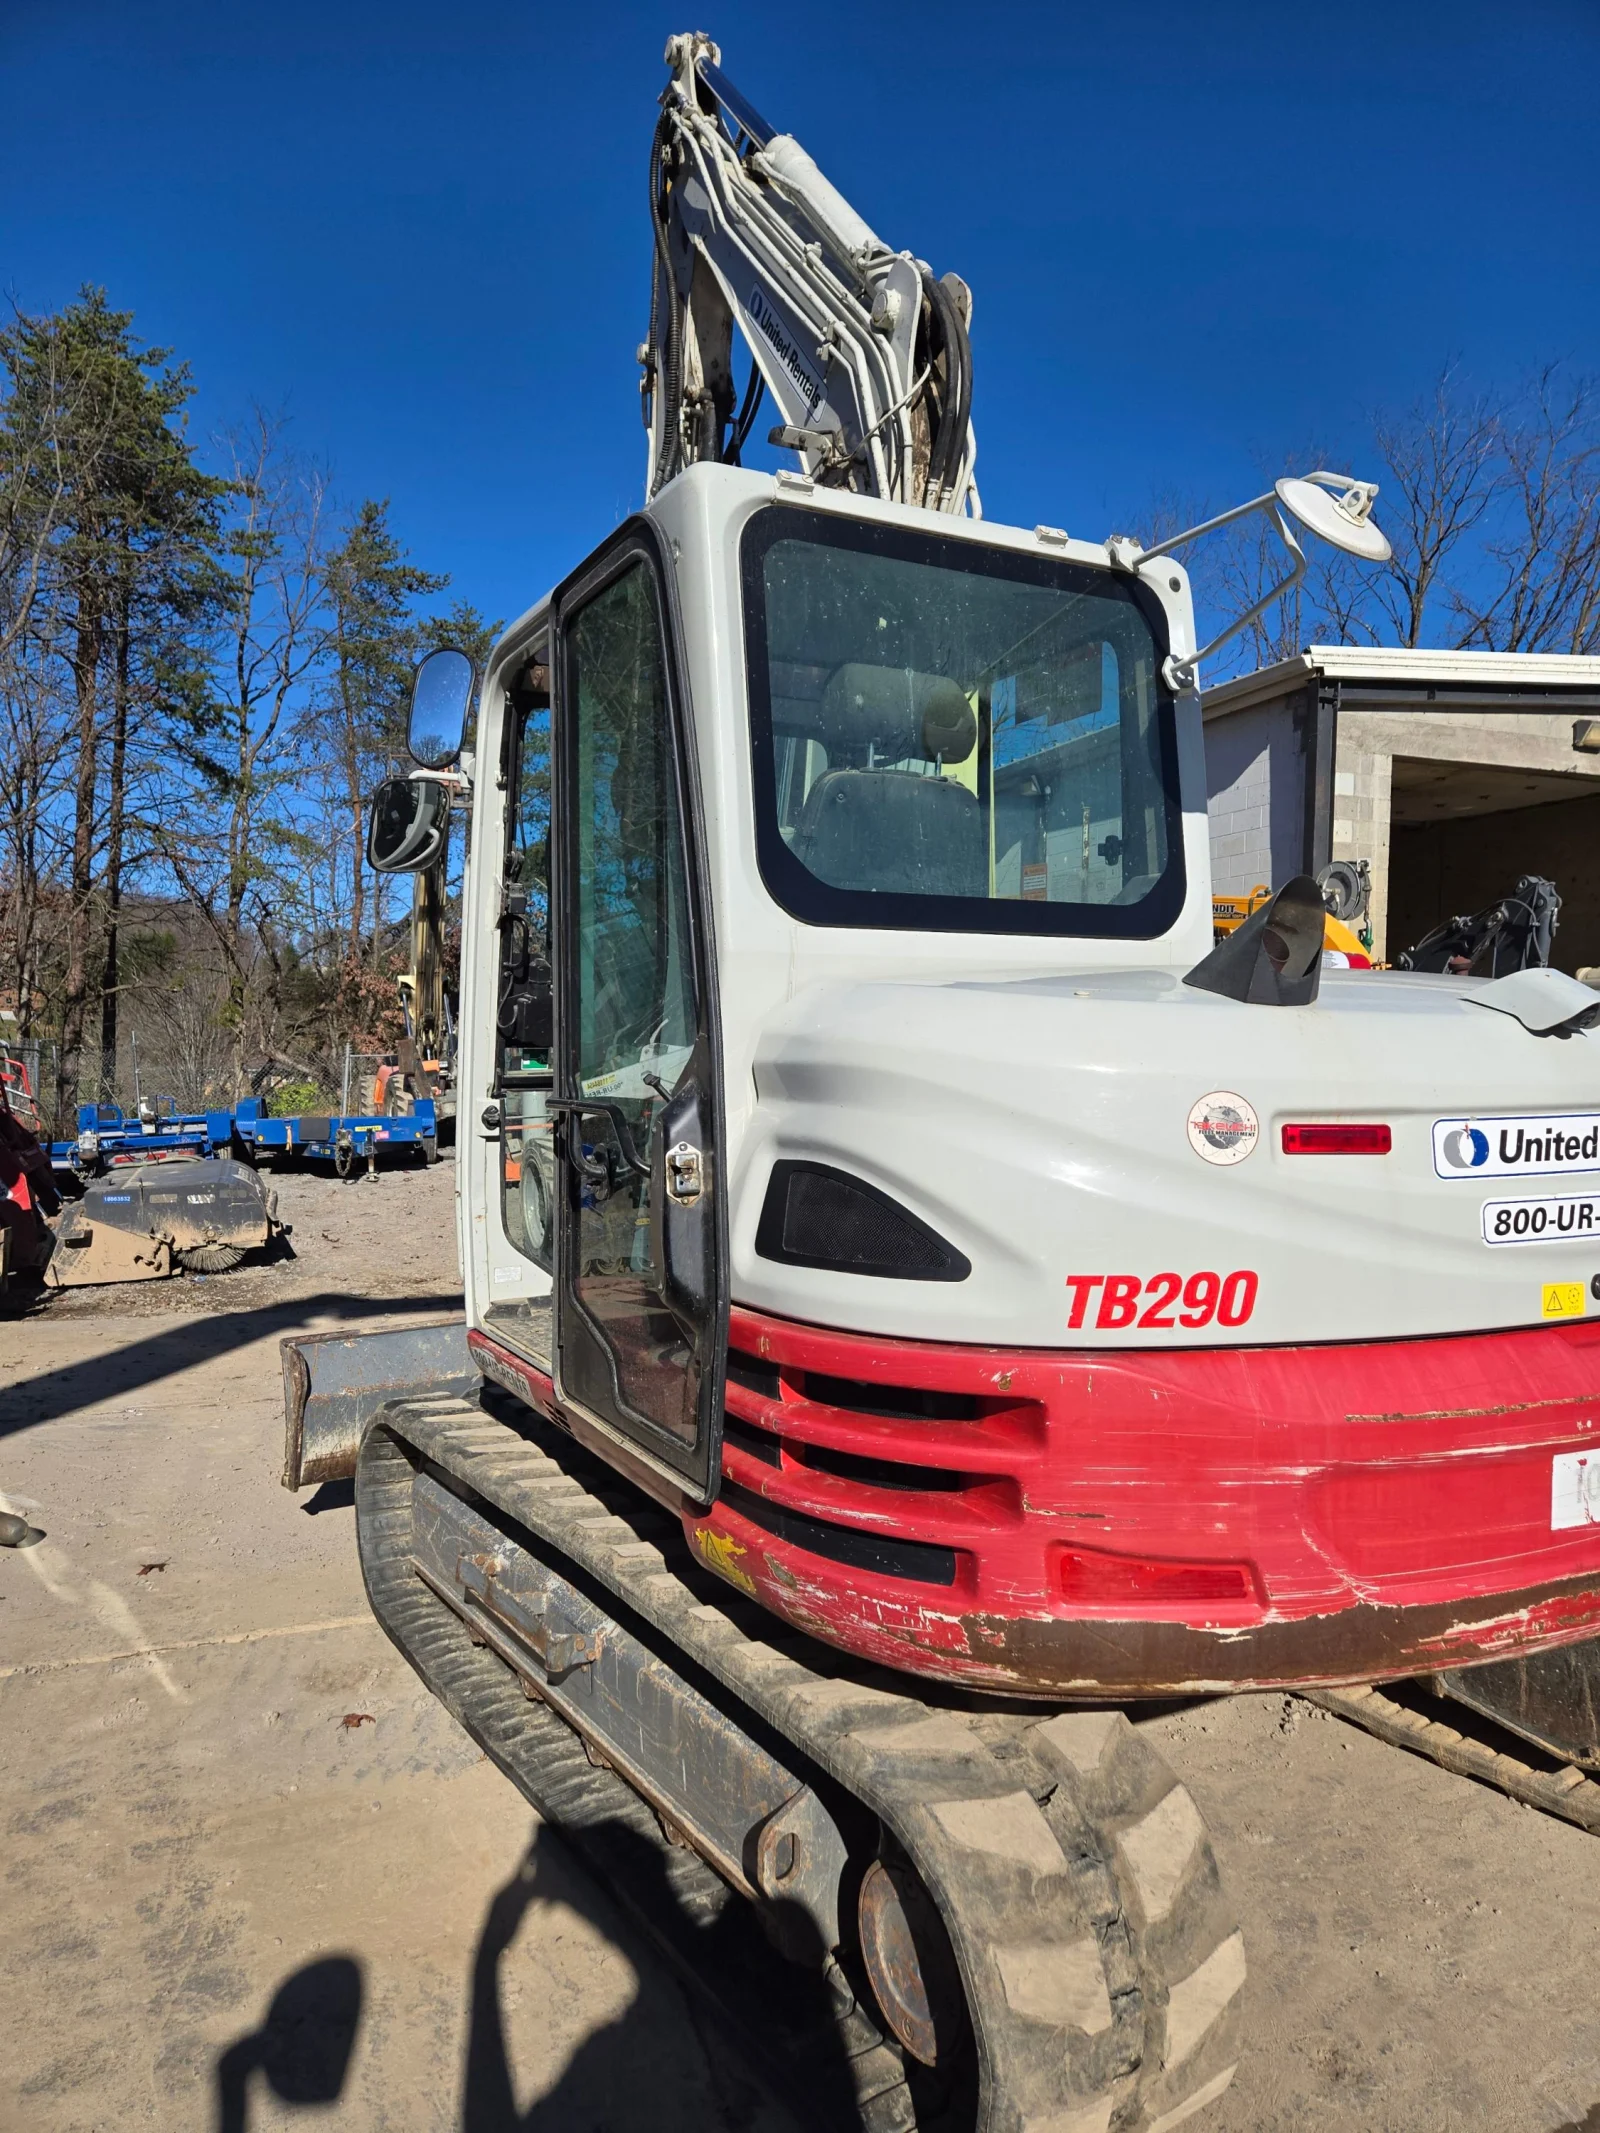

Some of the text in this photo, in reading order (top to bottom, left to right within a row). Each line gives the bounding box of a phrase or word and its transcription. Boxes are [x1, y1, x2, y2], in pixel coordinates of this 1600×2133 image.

[761, 311, 821, 409] United Rentals
[1216, 1130, 1256, 1138] MANAGEMENT
[1499, 1126, 1599, 1164] United
[1066, 1270, 1259, 1329] TB290
